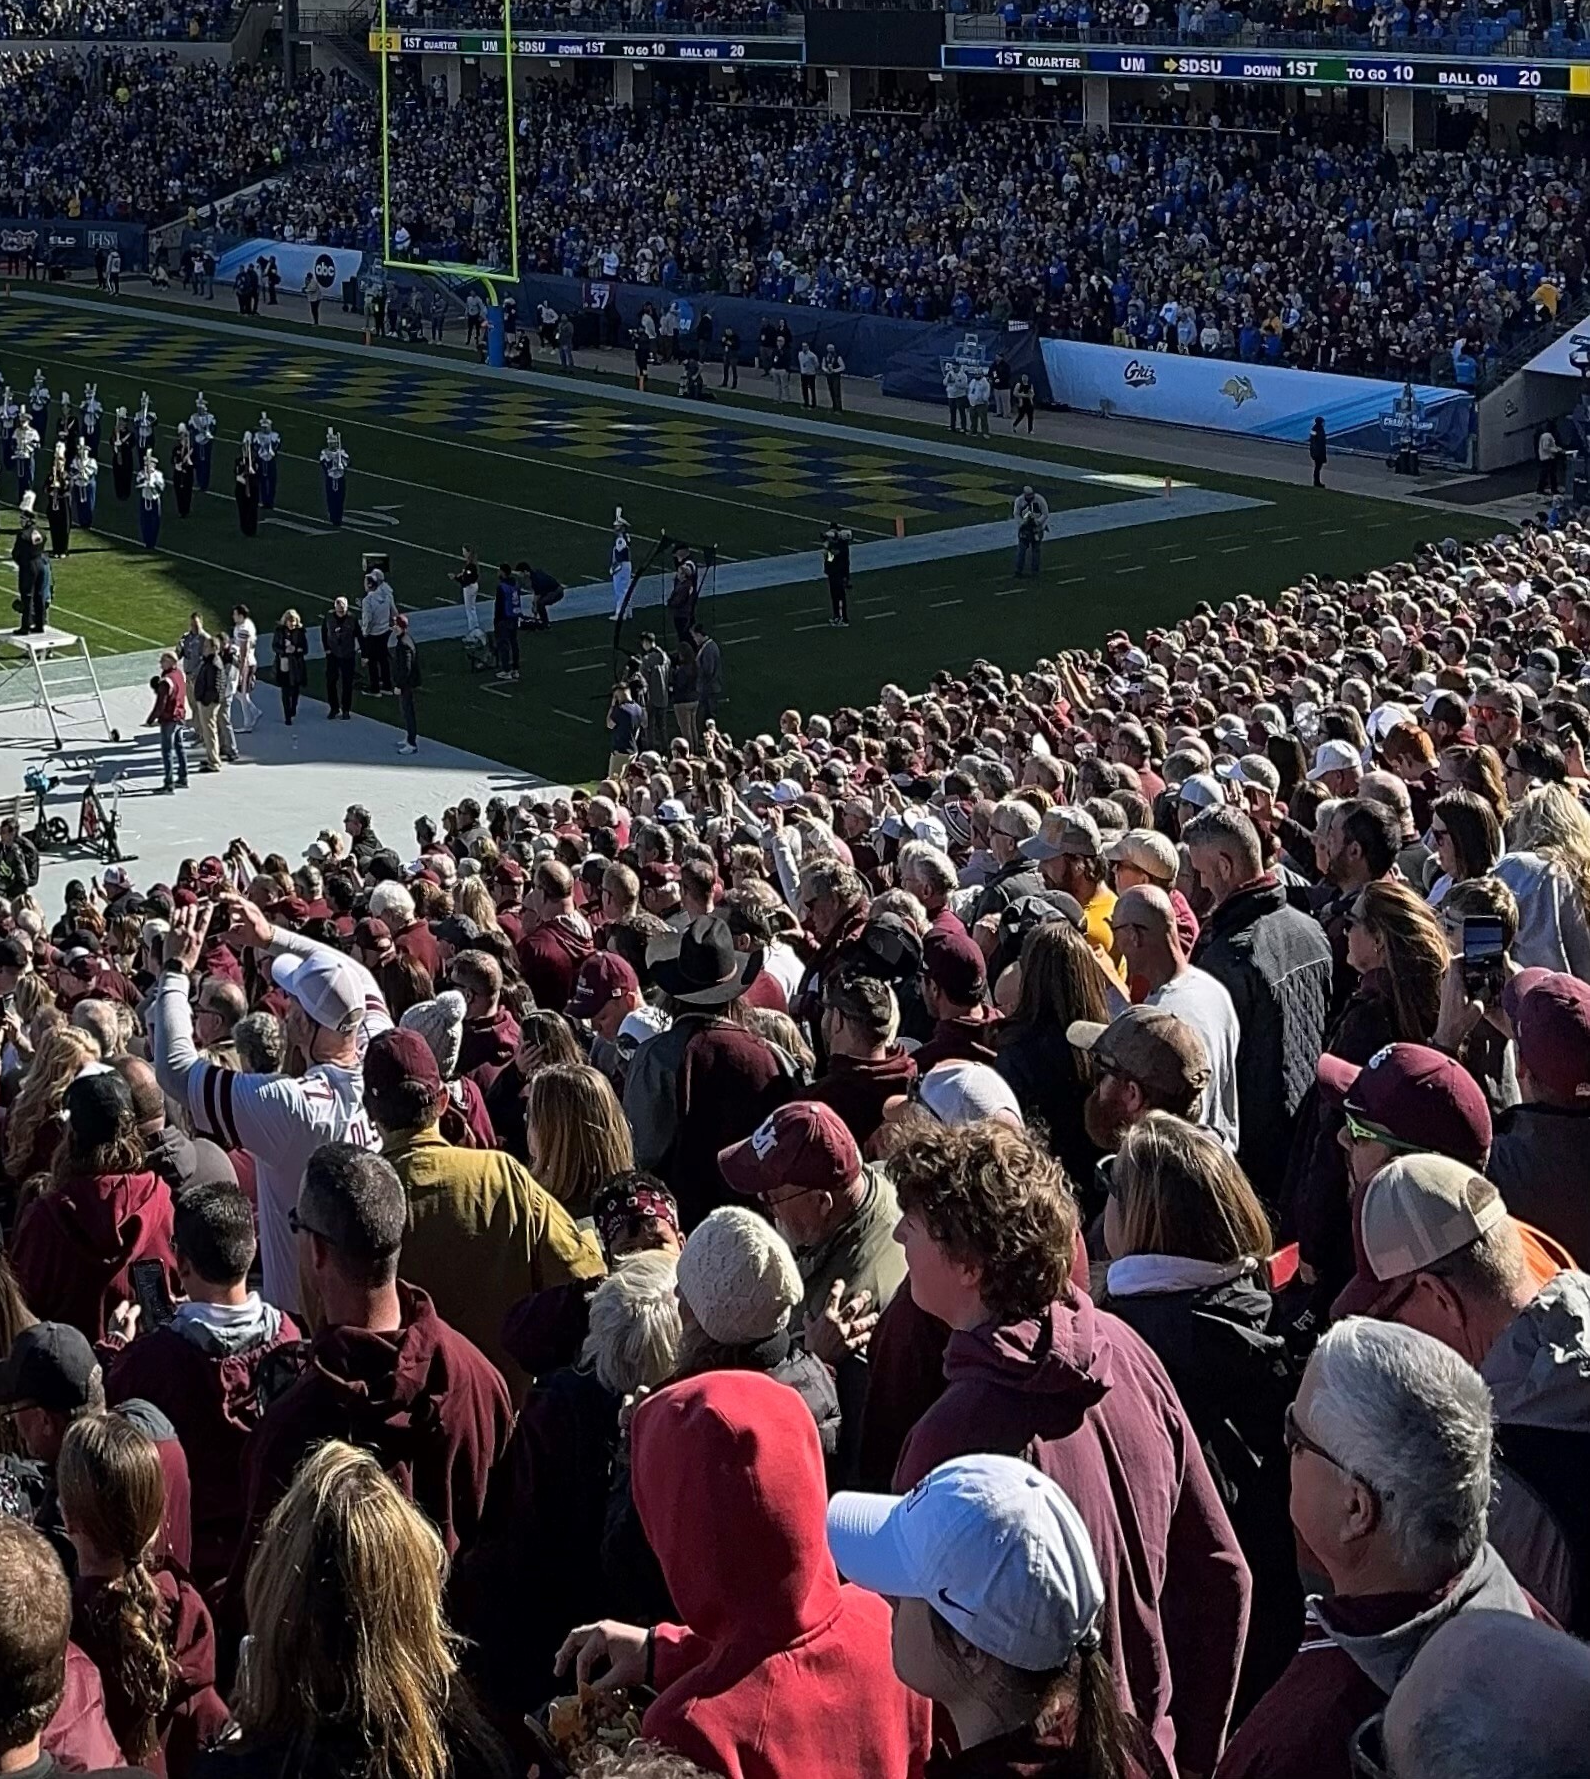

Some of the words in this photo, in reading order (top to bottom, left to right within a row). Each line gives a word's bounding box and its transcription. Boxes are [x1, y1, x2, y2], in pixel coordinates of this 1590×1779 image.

[403, 38, 421, 48] 1ST
[424, 41, 457, 50] QUARTER
[482, 41, 497, 52] UM
[519, 41, 545, 52] SDSU
[585, 42, 605, 53] 1ST
[623, 46, 634, 55] TO
[636, 47, 648, 55] GO
[652, 44, 665, 55] 10
[680, 48, 702, 57] BALL
[705, 48, 717, 57] ON
[730, 45, 744, 57] 20
[996, 52, 1022, 64] 1ST
[1028, 56, 1081, 68] QUARTER
[1121, 57, 1145, 71] UM
[1179, 59, 1222, 72] SDSU
[1244, 64, 1281, 76] DOWN
[1286, 62, 1318, 75] 1ST
[1347, 68, 1364, 79] TO
[1368, 69, 1387, 80] GO
[1394, 66, 1414, 80] 10
[1439, 73, 1474, 84] BALL
[1478, 74, 1498, 85] ON
[1519, 71, 1541, 85] 20
[316, 262, 335, 277] abc
[591, 290, 609, 309] 37
[1124, 360, 1155, 380] Griz
